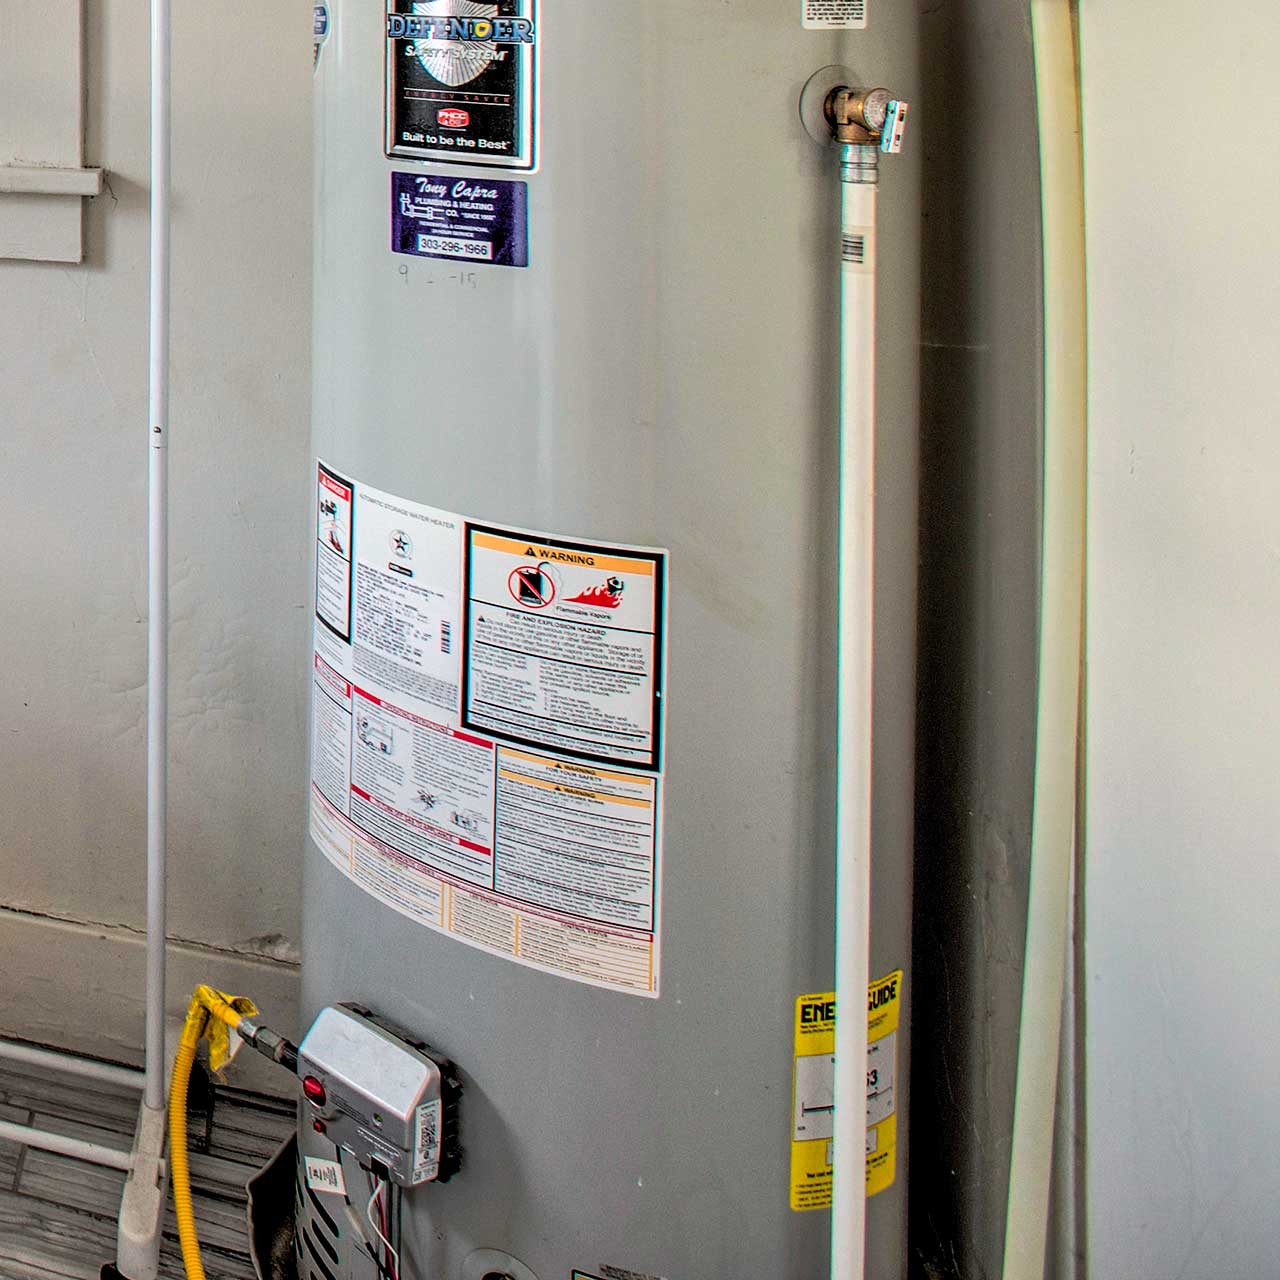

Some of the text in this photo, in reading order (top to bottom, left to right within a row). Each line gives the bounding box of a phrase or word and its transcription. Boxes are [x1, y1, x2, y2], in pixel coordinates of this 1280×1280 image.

[389, 15, 533, 42] DEFENDER
[452, 48, 506, 60] SYSTEM
[402, 132, 507, 150] Built to be the Best
[416, 178, 498, 200] Tony Capra
[414, 197, 451, 207] PLUMBING
[459, 202, 494, 211] HEATING
[421, 238, 488, 255] 303-296-1966
[540, 549, 594, 566] WARNING
[577, 627, 606, 636] HAZARD
[801, 1002, 835, 1023] ENE
